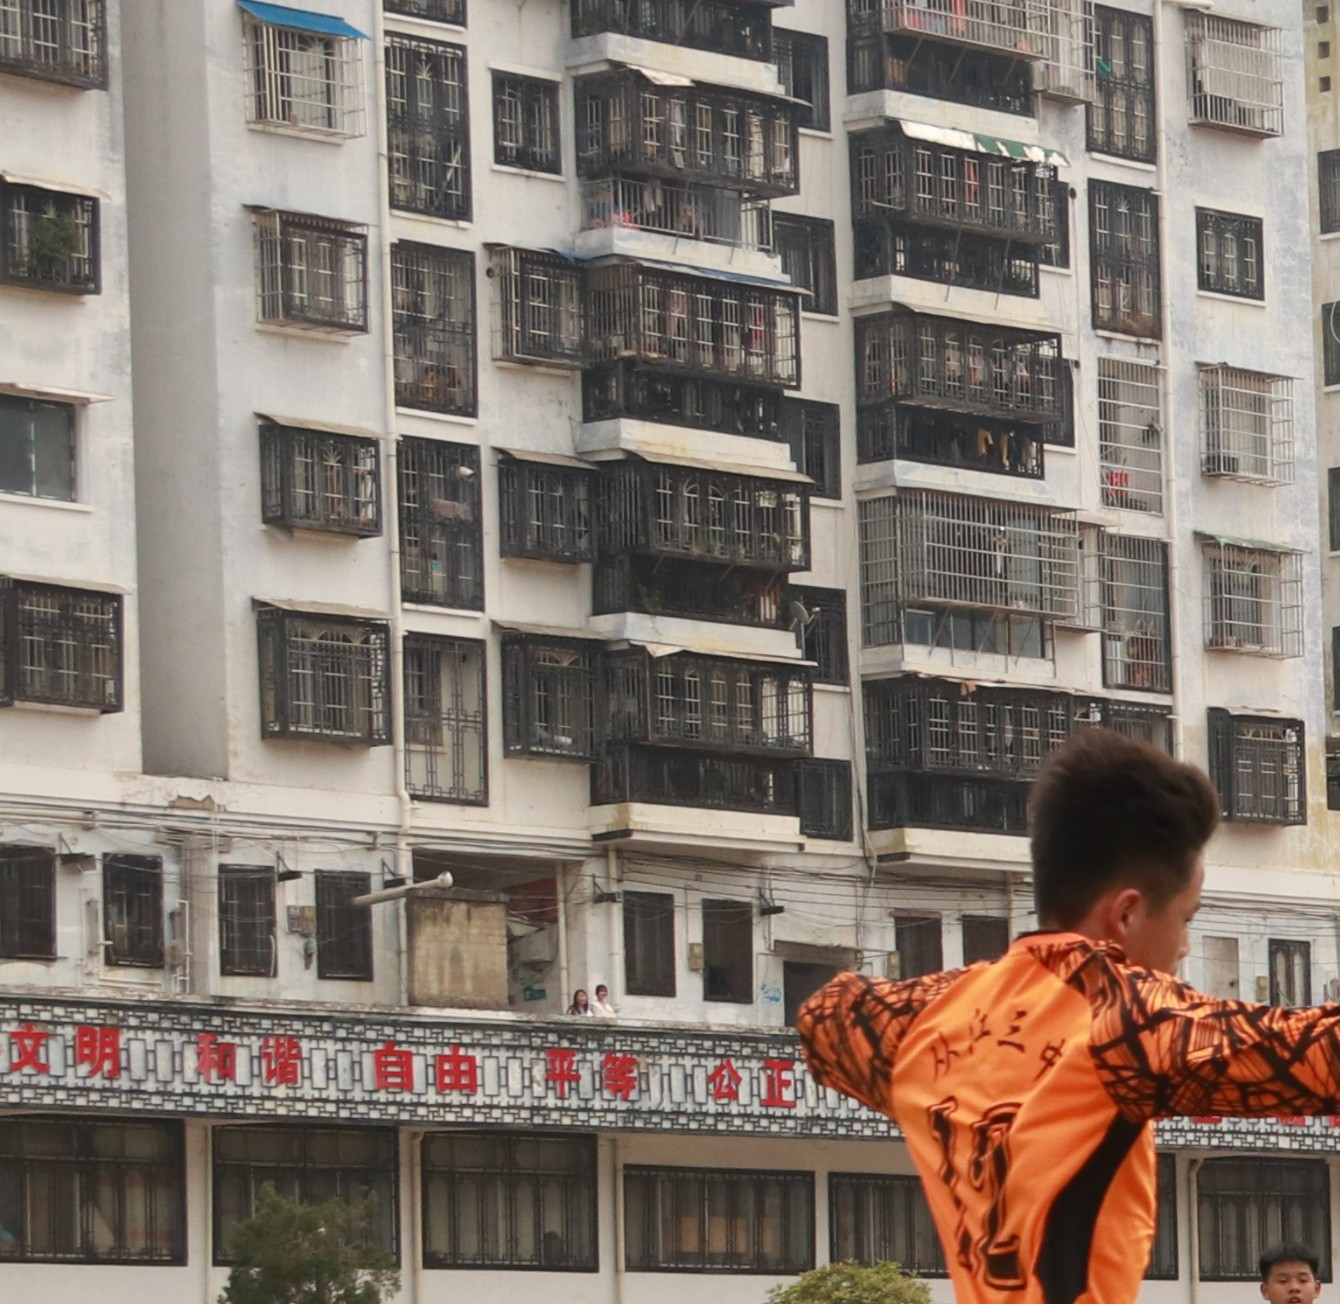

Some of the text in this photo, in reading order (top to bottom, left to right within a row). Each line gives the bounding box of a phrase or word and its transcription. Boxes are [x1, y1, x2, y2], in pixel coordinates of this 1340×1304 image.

[10, 1024, 121, 1079] 文明
[197, 1034, 303, 1086] 和谐
[374, 1042, 479, 1094] 自由
[547, 1049, 638, 1101] 平等
[708, 1059, 797, 1109] 公正
